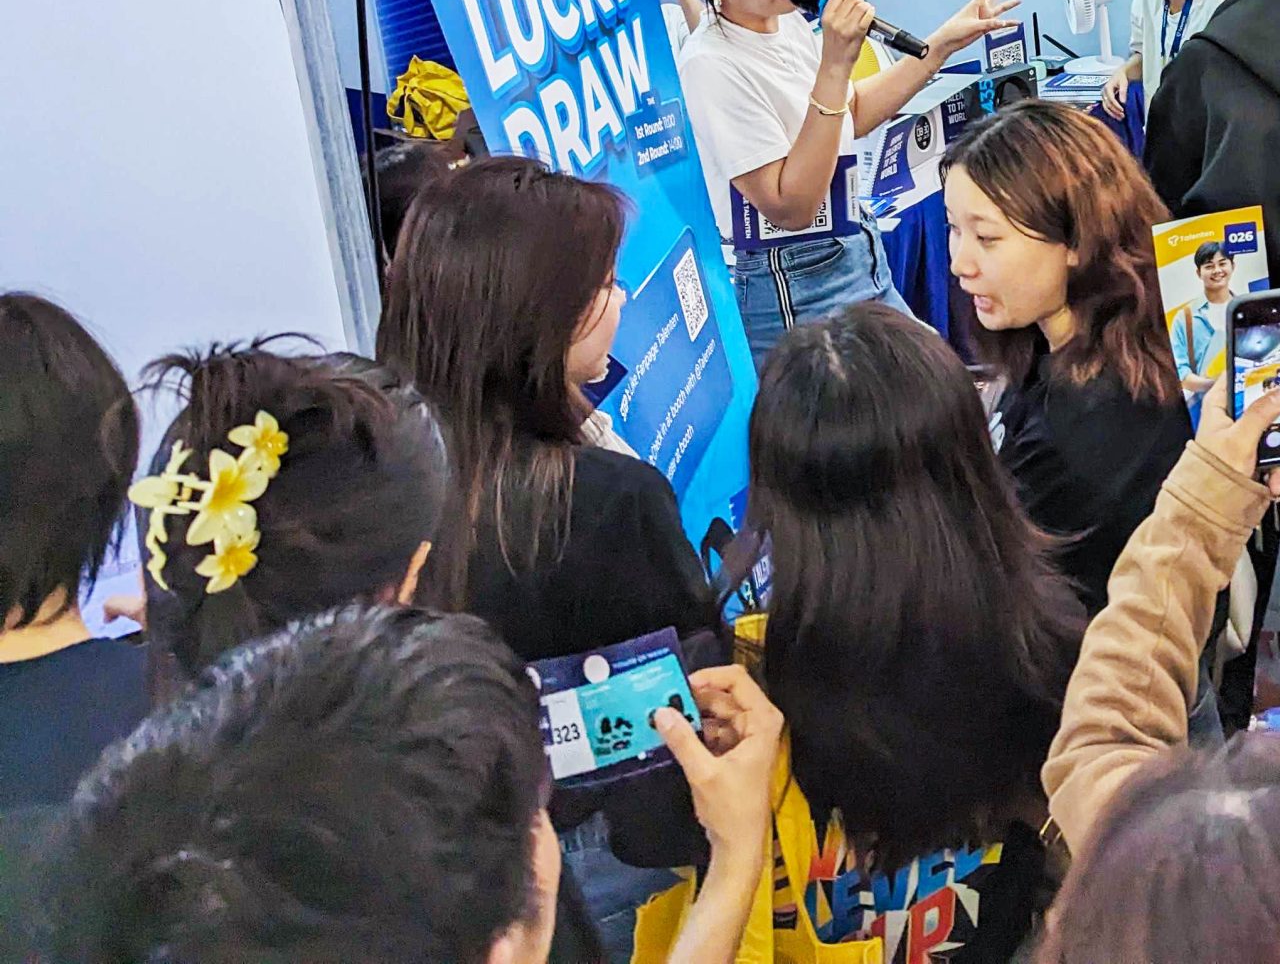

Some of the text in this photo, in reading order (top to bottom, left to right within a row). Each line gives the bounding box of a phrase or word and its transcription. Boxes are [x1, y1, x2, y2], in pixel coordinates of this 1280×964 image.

[502, 17, 650, 176] DRAW
[948, 112, 968, 125] WORL
[637, 148, 651, 166] 2nd
[1228, 231, 1254, 244] 026
[656, 313, 679, 348] Talenten
[553, 723, 581, 745] 323
